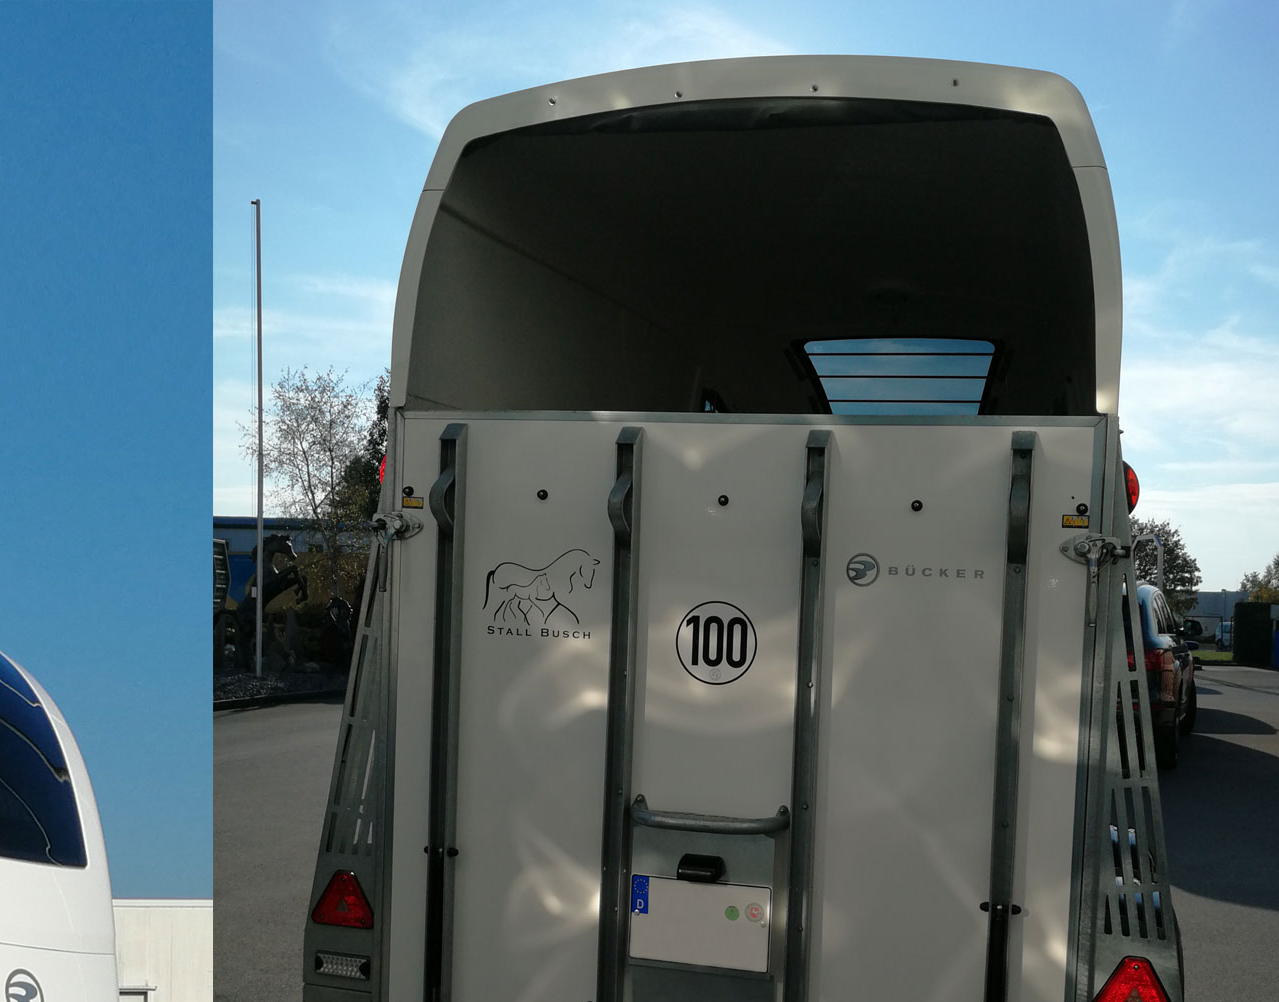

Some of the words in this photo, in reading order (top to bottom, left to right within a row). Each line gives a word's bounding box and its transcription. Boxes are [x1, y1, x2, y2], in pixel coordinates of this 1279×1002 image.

[888, 565, 985, 579] BÜCKER
[487, 626, 531, 636] STALL
[541, 628, 591, 639] BUSCH
[686, 615, 748, 668] 100
[636, 899, 644, 909] D
